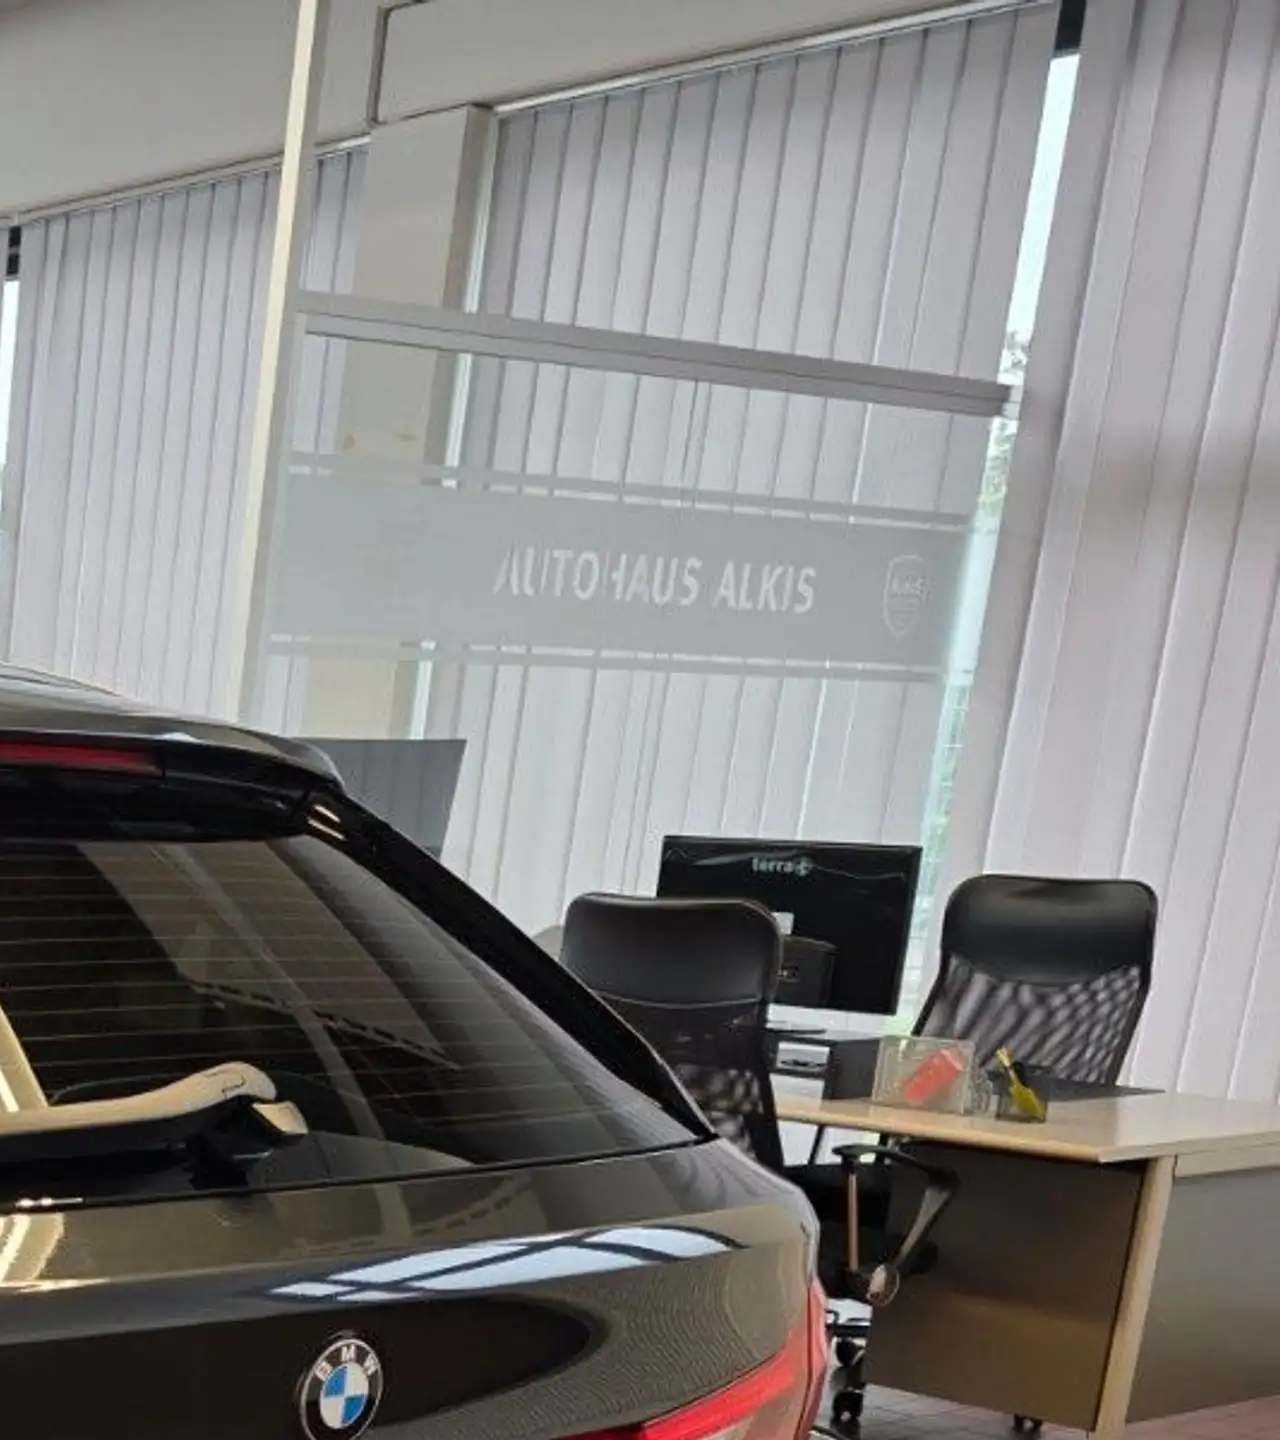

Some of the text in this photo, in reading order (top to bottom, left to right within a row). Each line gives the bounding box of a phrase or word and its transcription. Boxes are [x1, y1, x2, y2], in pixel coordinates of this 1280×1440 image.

[493, 545, 817, 615] AUTOHAUS ALKIS
[313, 1343, 381, 1381] BMW
